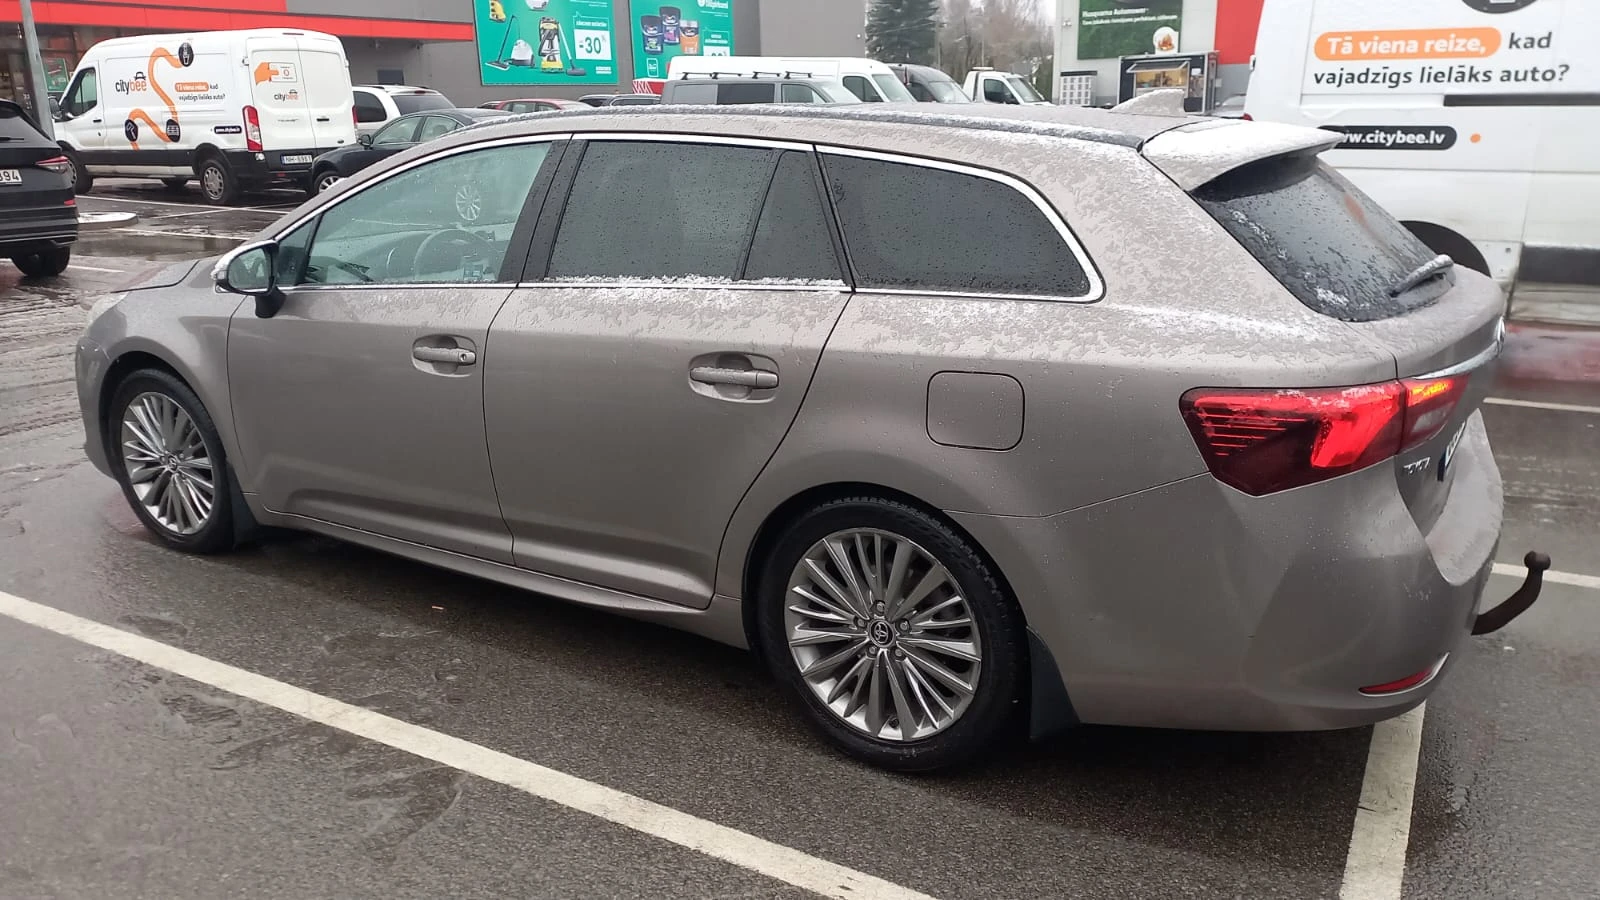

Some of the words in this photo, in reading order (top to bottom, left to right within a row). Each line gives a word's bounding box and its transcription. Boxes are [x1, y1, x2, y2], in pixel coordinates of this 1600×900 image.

[1328, 37, 1353, 55] Tā
[1359, 36, 1418, 54] viena
[1424, 34, 1486, 55] reize,
[1508, 31, 1553, 49] kad
[1314, 66, 1413, 88] vajadzīgs
[1420, 65, 1492, 84] lielāks
[1500, 64, 1569, 82] auto?
[115, 80, 147, 95] citybee
[1343, 129, 1446, 146] w.citybee.lv
